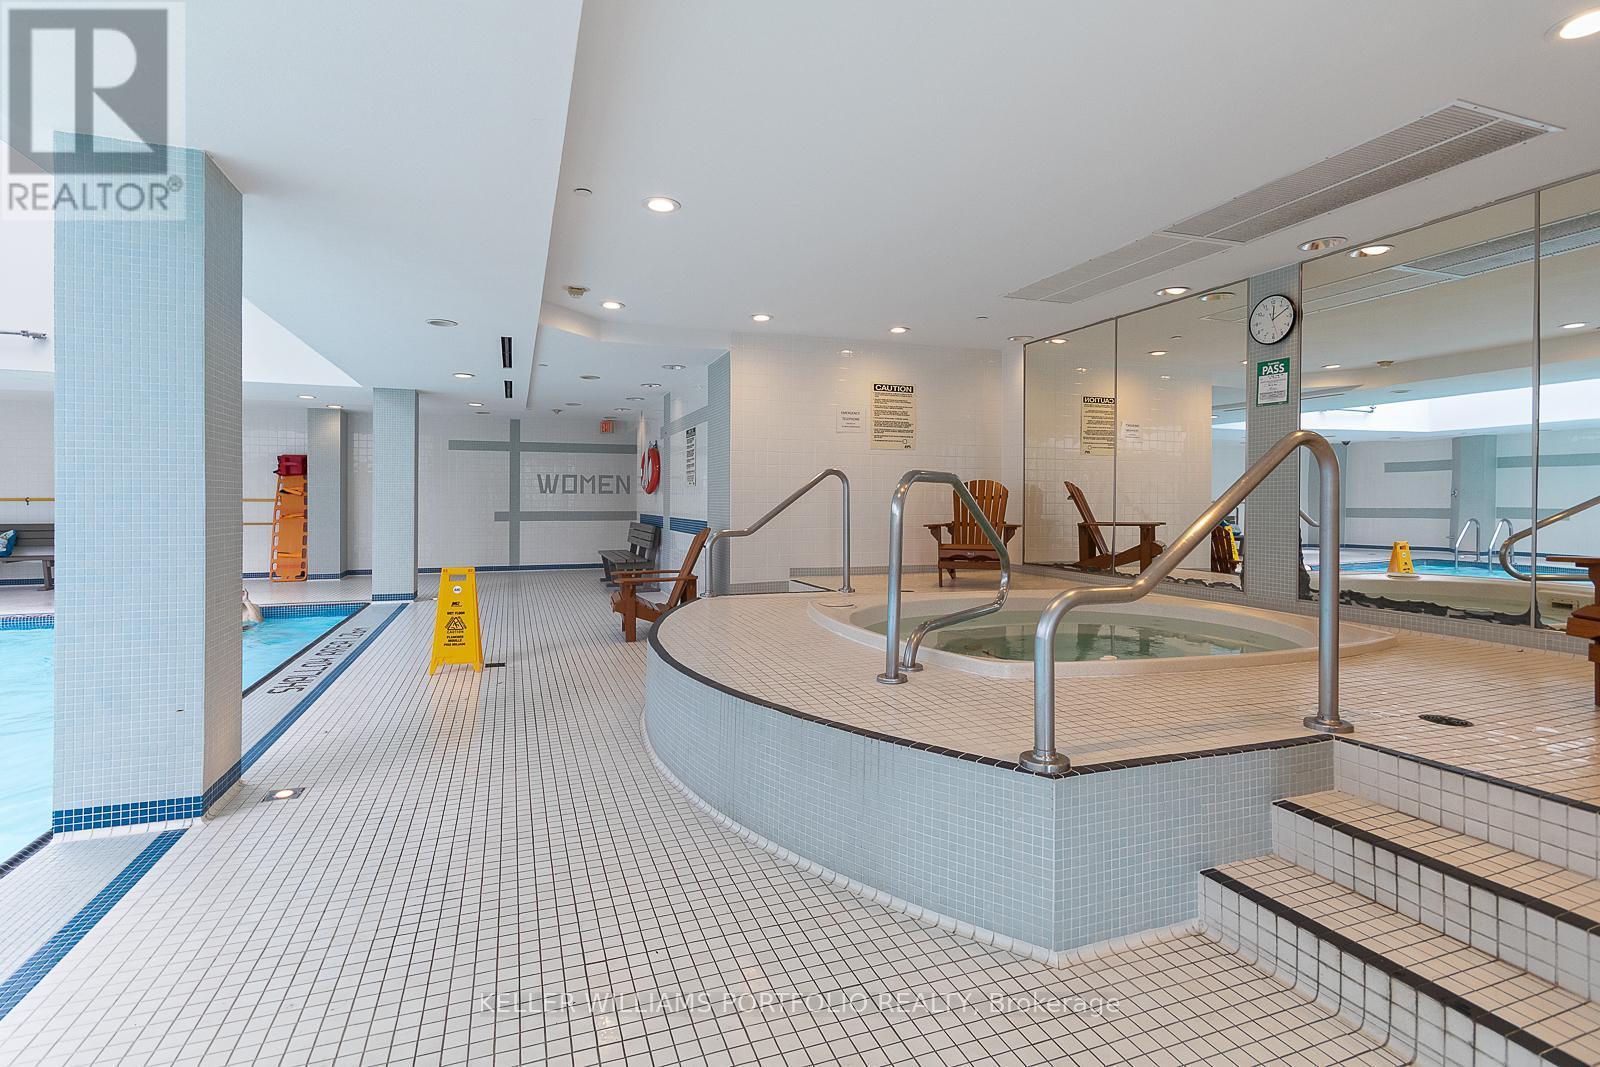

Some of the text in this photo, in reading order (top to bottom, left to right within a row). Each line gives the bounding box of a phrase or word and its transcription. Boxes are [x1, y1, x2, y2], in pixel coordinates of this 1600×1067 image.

[1262, 363, 1285, 375] PASS
[875, 384, 912, 393] CAUTION
[536, 473, 631, 495] WOMEN
[266, 657, 336, 694] SHALLOW
[314, 640, 355, 656] AREA
